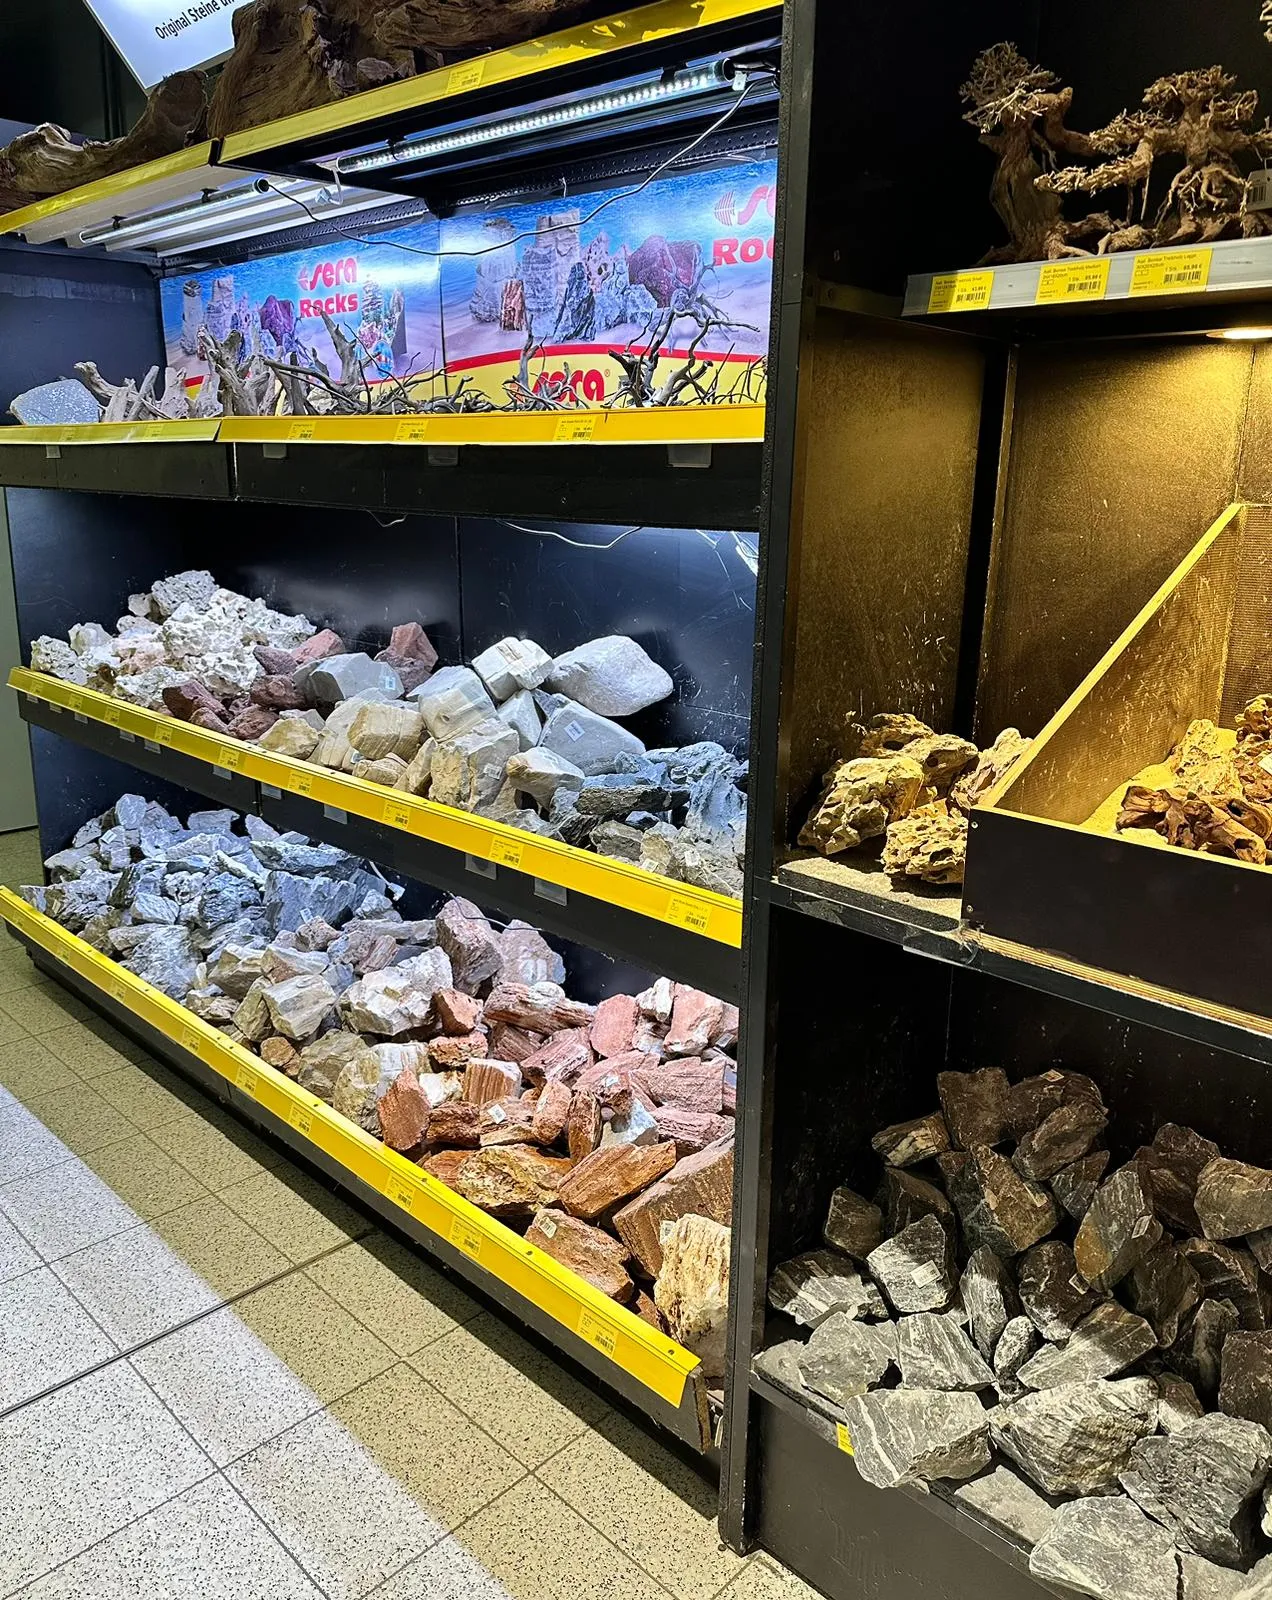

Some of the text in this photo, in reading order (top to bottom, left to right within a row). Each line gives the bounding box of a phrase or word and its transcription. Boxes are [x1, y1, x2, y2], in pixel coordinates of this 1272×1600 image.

[155, 12, 192, 39] Original
[187, 0, 221, 22] Steine
[310, 257, 357, 291] sera
